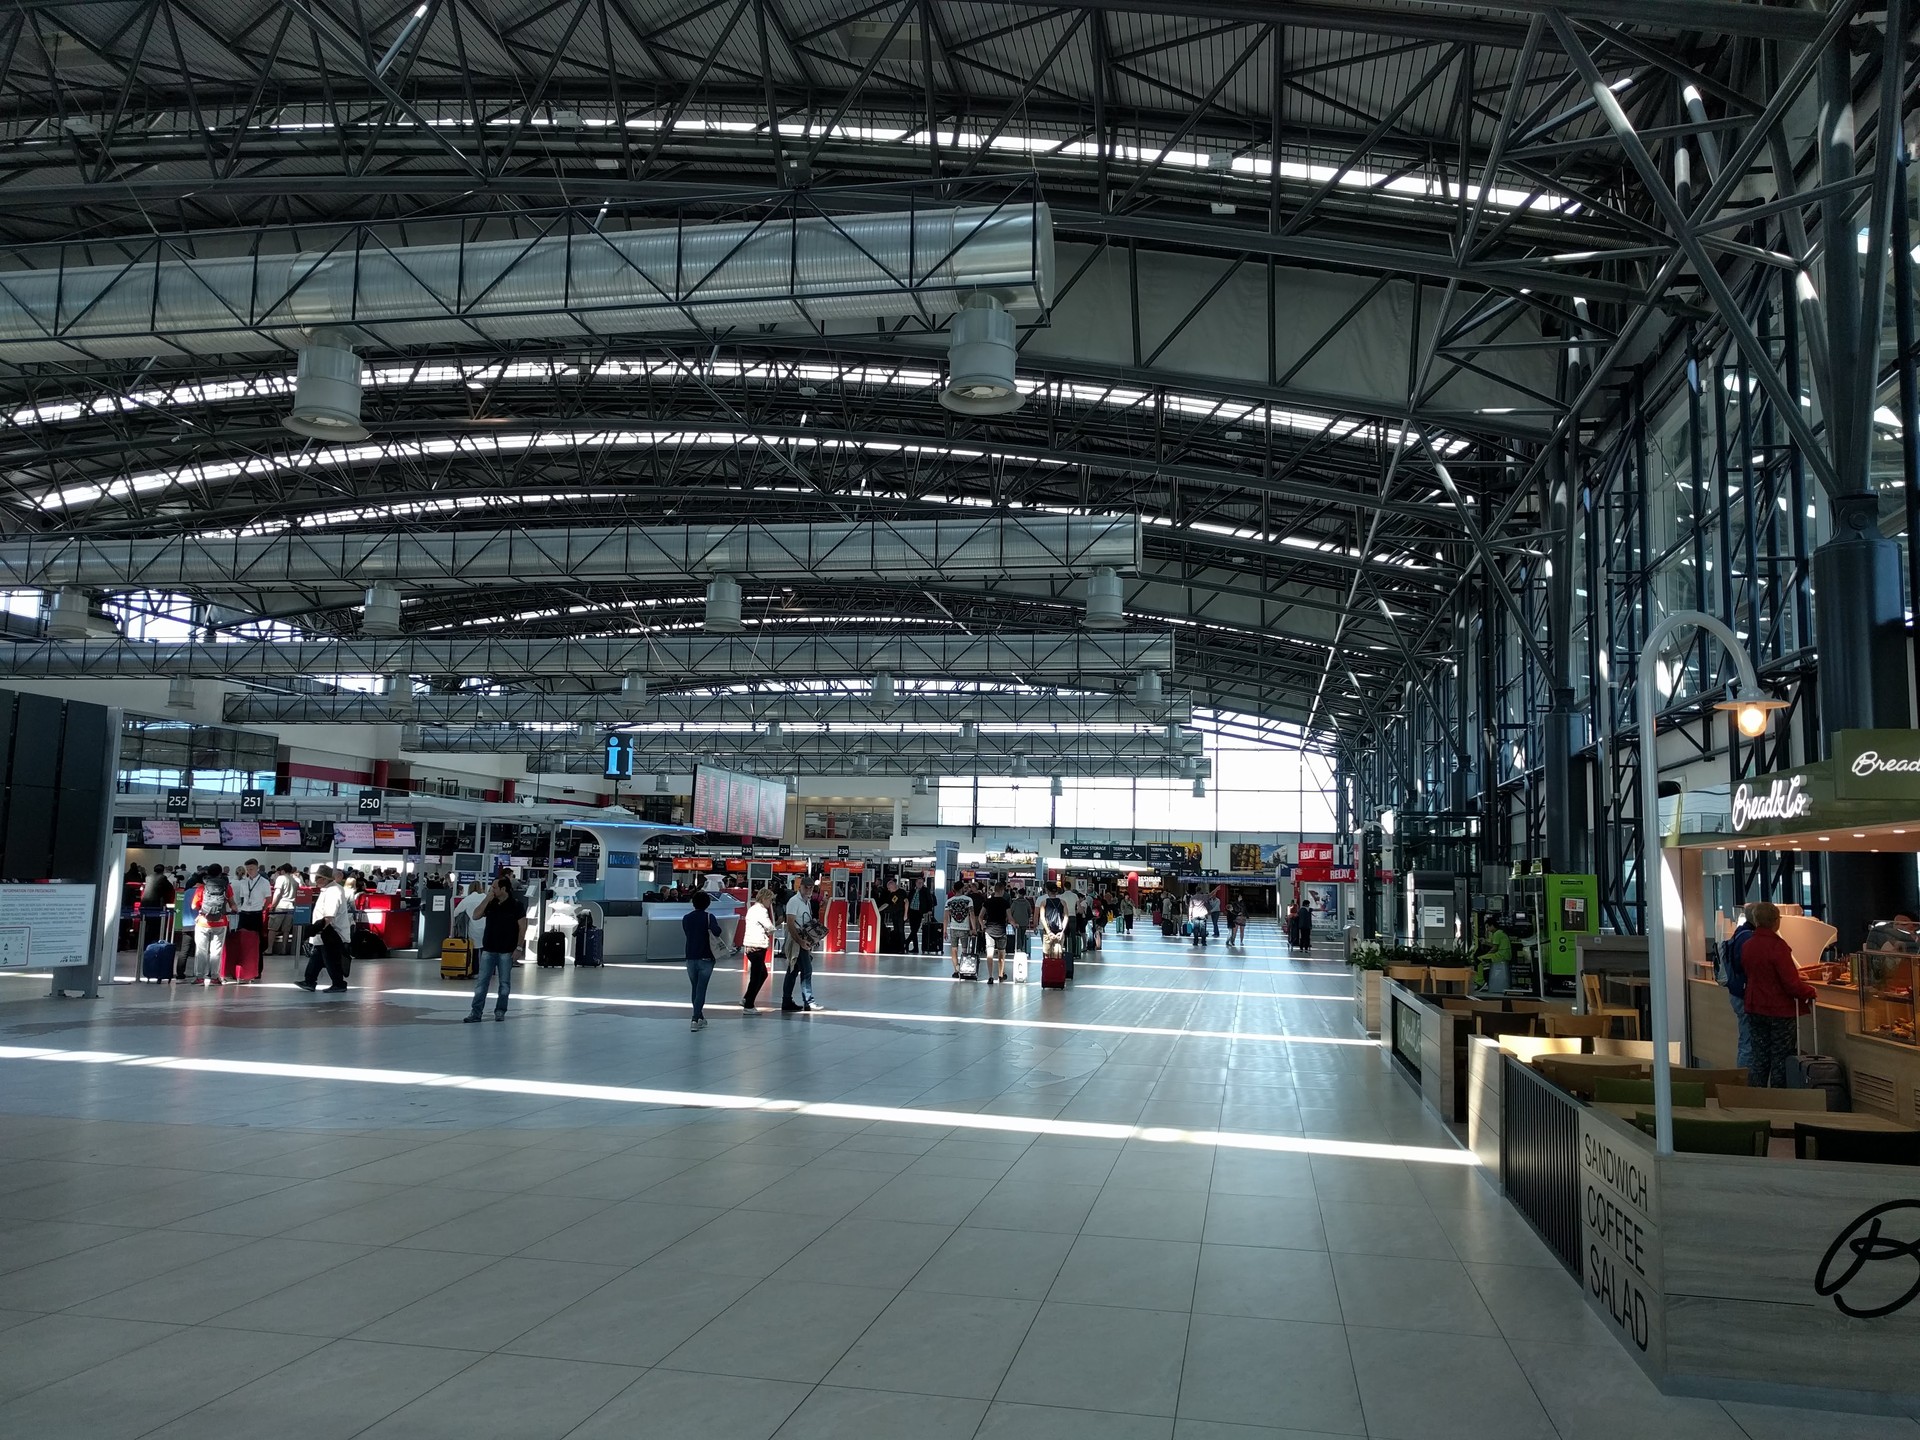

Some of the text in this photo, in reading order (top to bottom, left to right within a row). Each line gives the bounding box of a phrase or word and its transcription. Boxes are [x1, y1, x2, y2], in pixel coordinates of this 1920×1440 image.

[168, 796, 188, 806] 252
[243, 797, 261, 807] 251
[360, 799, 379, 809] 250
[1300, 849, 1316, 860] RELAY
[1319, 850, 1332, 860] RELAY
[1330, 869, 1351, 880] RELAY
[1585, 1133, 1648, 1212] SANDWICH
[1587, 1185, 1645, 1276] COFFEE
[1590, 1243, 1649, 1352] SALAD
